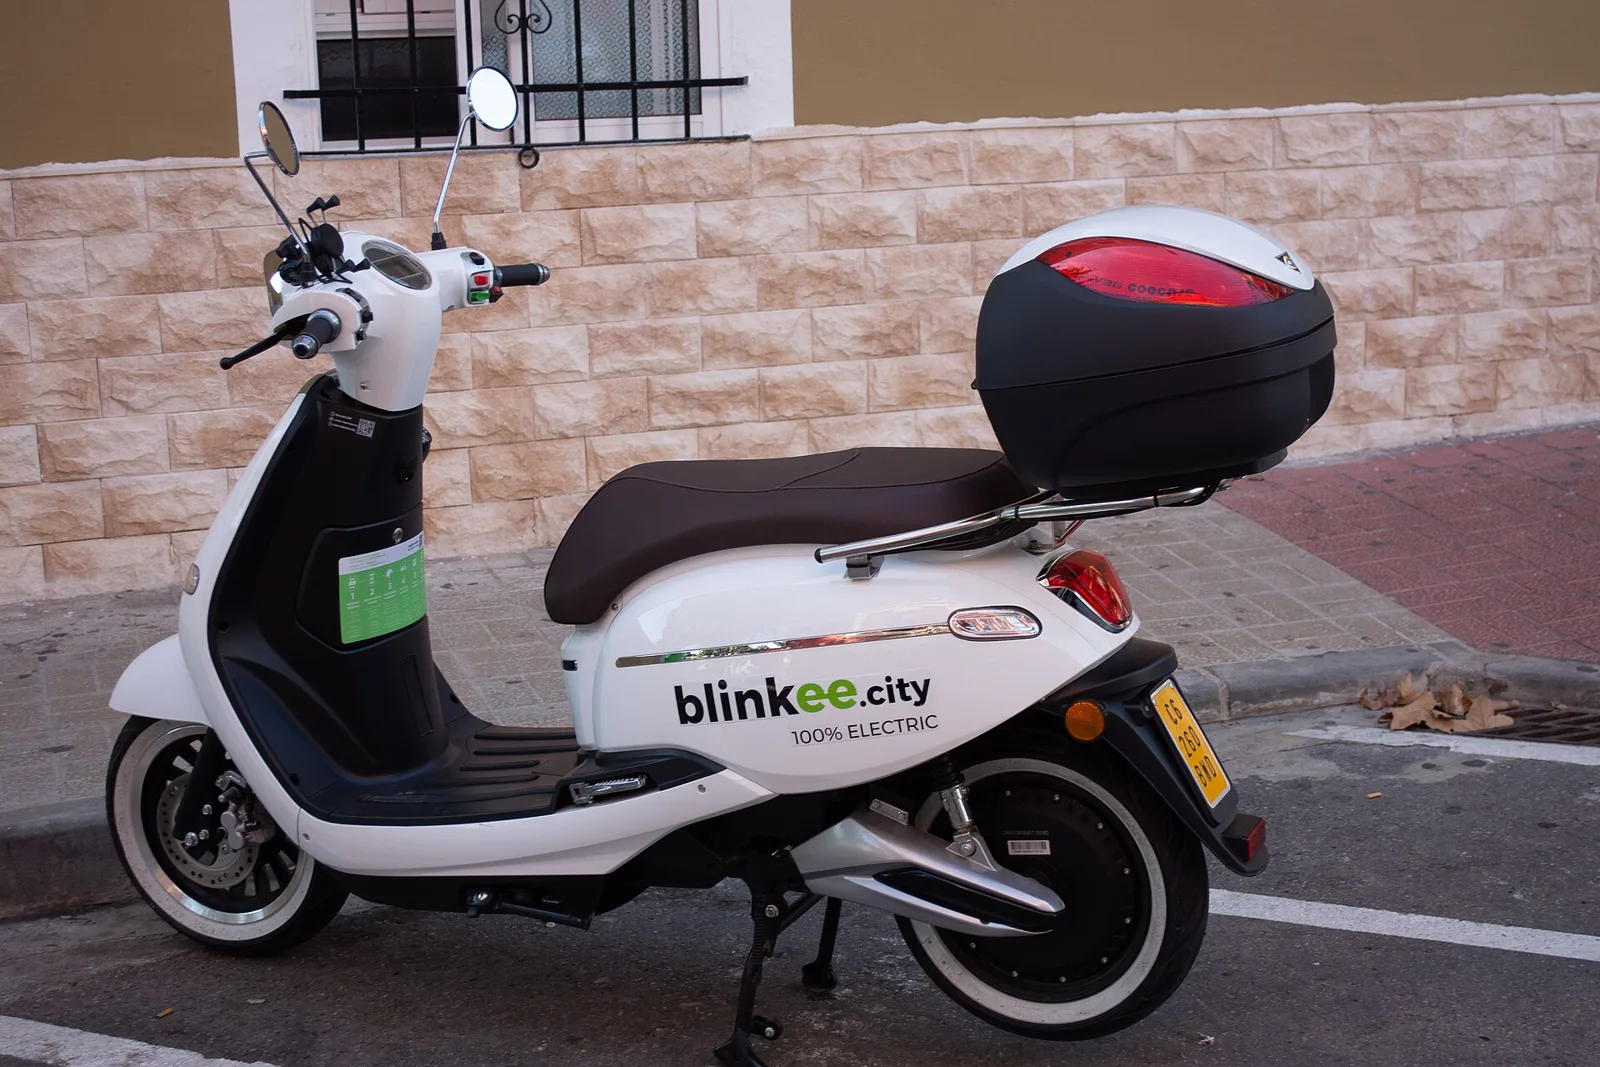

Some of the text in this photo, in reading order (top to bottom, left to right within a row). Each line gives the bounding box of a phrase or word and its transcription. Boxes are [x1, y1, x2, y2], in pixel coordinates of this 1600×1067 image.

[674, 676, 931, 725] blinkee.city
[1164, 699, 1183, 725] C6
[791, 714, 939, 745] 100% ELECTRIC
[1178, 725, 1201, 758] 260
